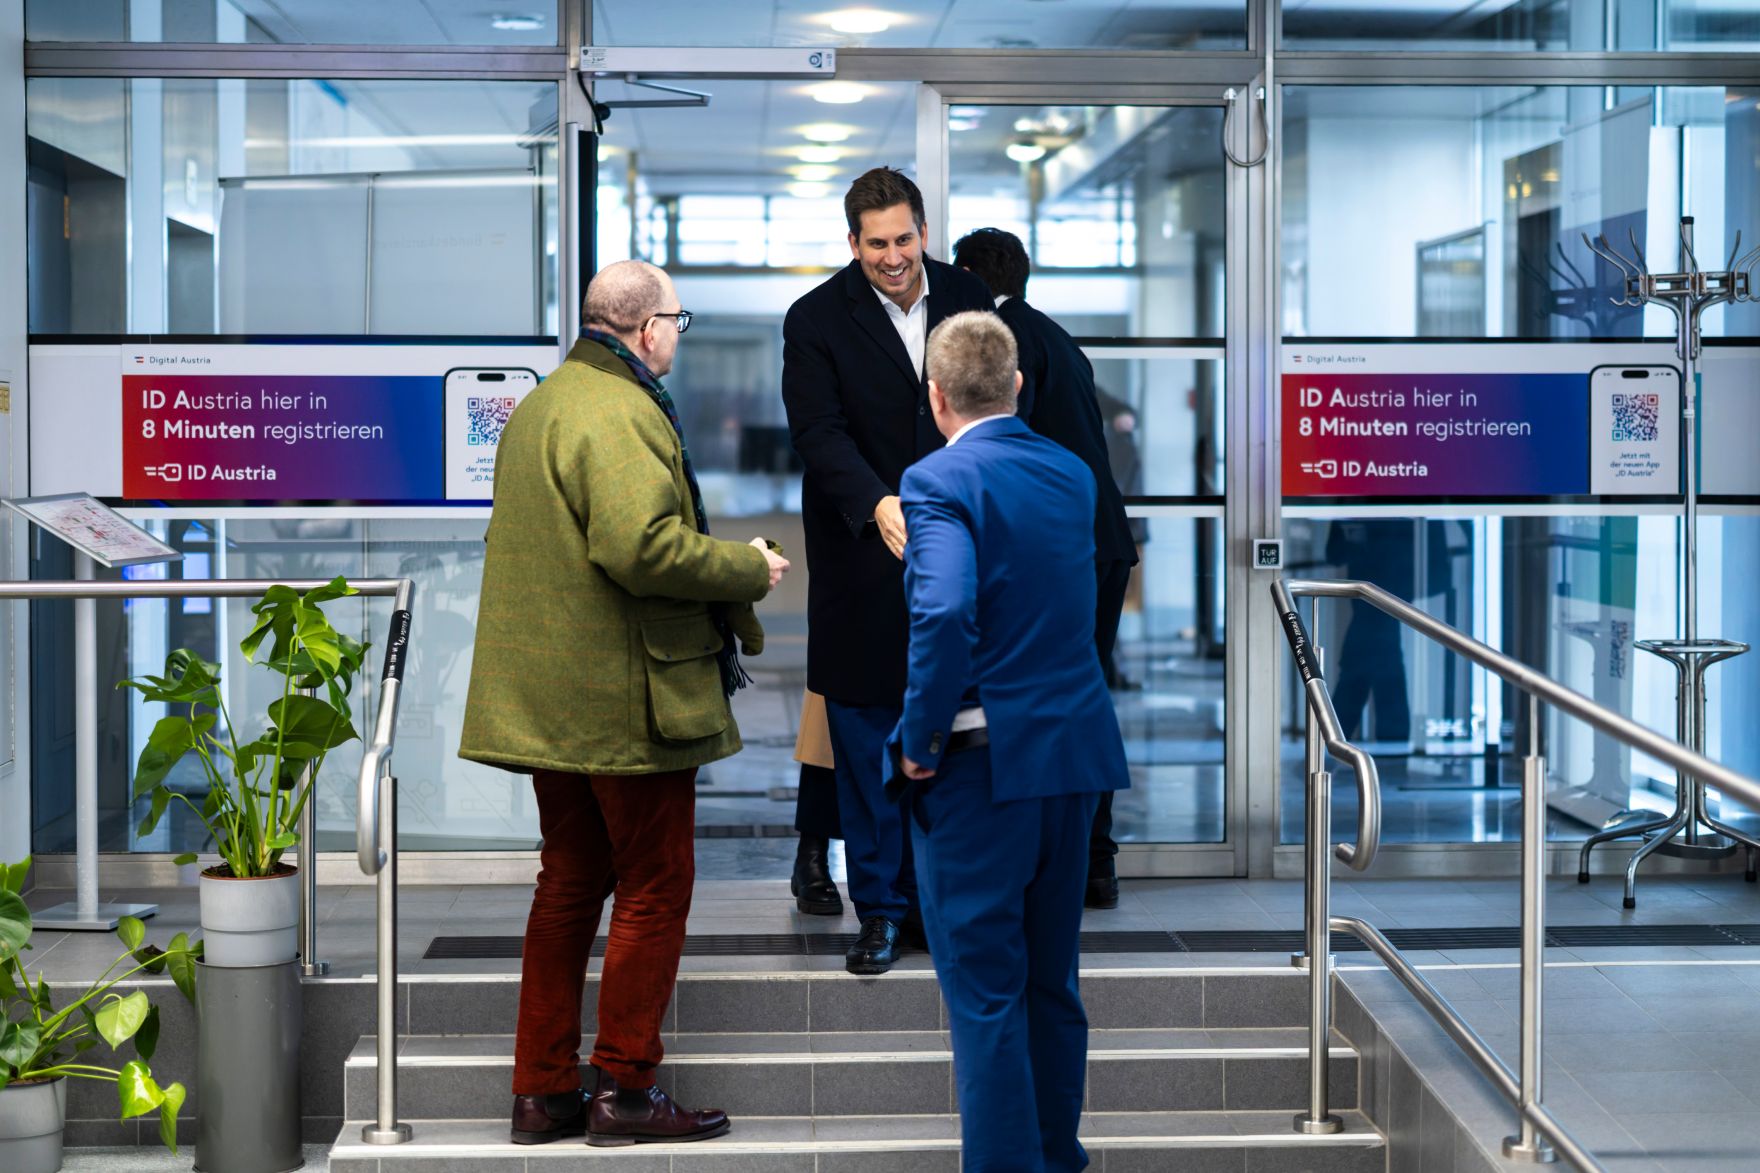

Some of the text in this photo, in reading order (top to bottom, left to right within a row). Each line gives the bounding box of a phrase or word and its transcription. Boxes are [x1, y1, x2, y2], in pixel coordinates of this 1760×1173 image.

[149, 356, 211, 366] Digital Austria
[1306, 355, 1366, 364] Digital Austria
[142, 389, 327, 409] ID Austria hier in
[1299, 387, 1477, 407] ID Austria hier in
[142, 419, 384, 445] 8 Minuten registrieren
[1299, 417, 1531, 442] 8 Minuten registrieren
[187, 464, 277, 481] ID Austria
[1342, 460, 1428, 477] ID Austria
[1260, 557, 1277, 565] AUF
